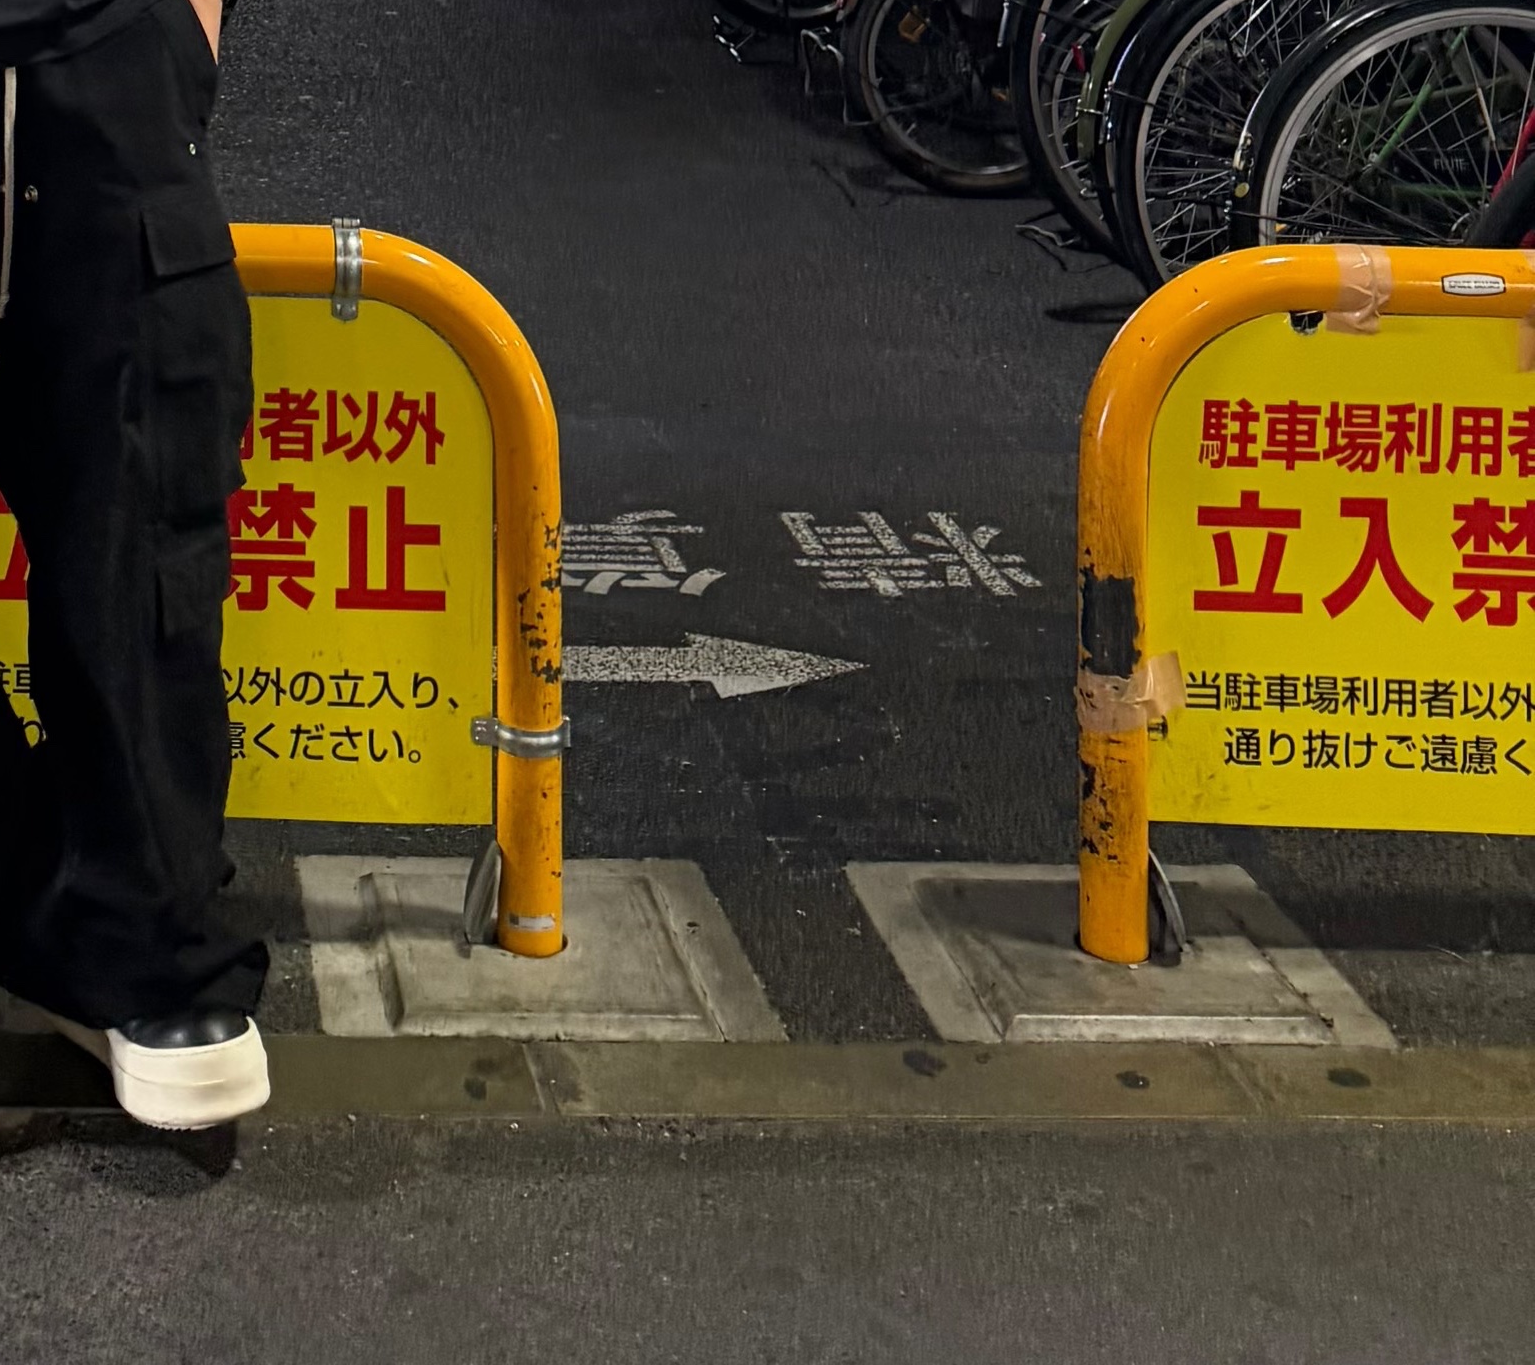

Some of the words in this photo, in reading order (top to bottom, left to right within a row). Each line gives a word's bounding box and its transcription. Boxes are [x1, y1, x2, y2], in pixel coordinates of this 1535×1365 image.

[238, 388, 445, 465] 者以外
[1193, 490, 1535, 626] 立入禁
[1185, 672, 1535, 722] 当駐車場利用者以外
[1224, 728, 1532, 776] 通り抜けご遠慮く
